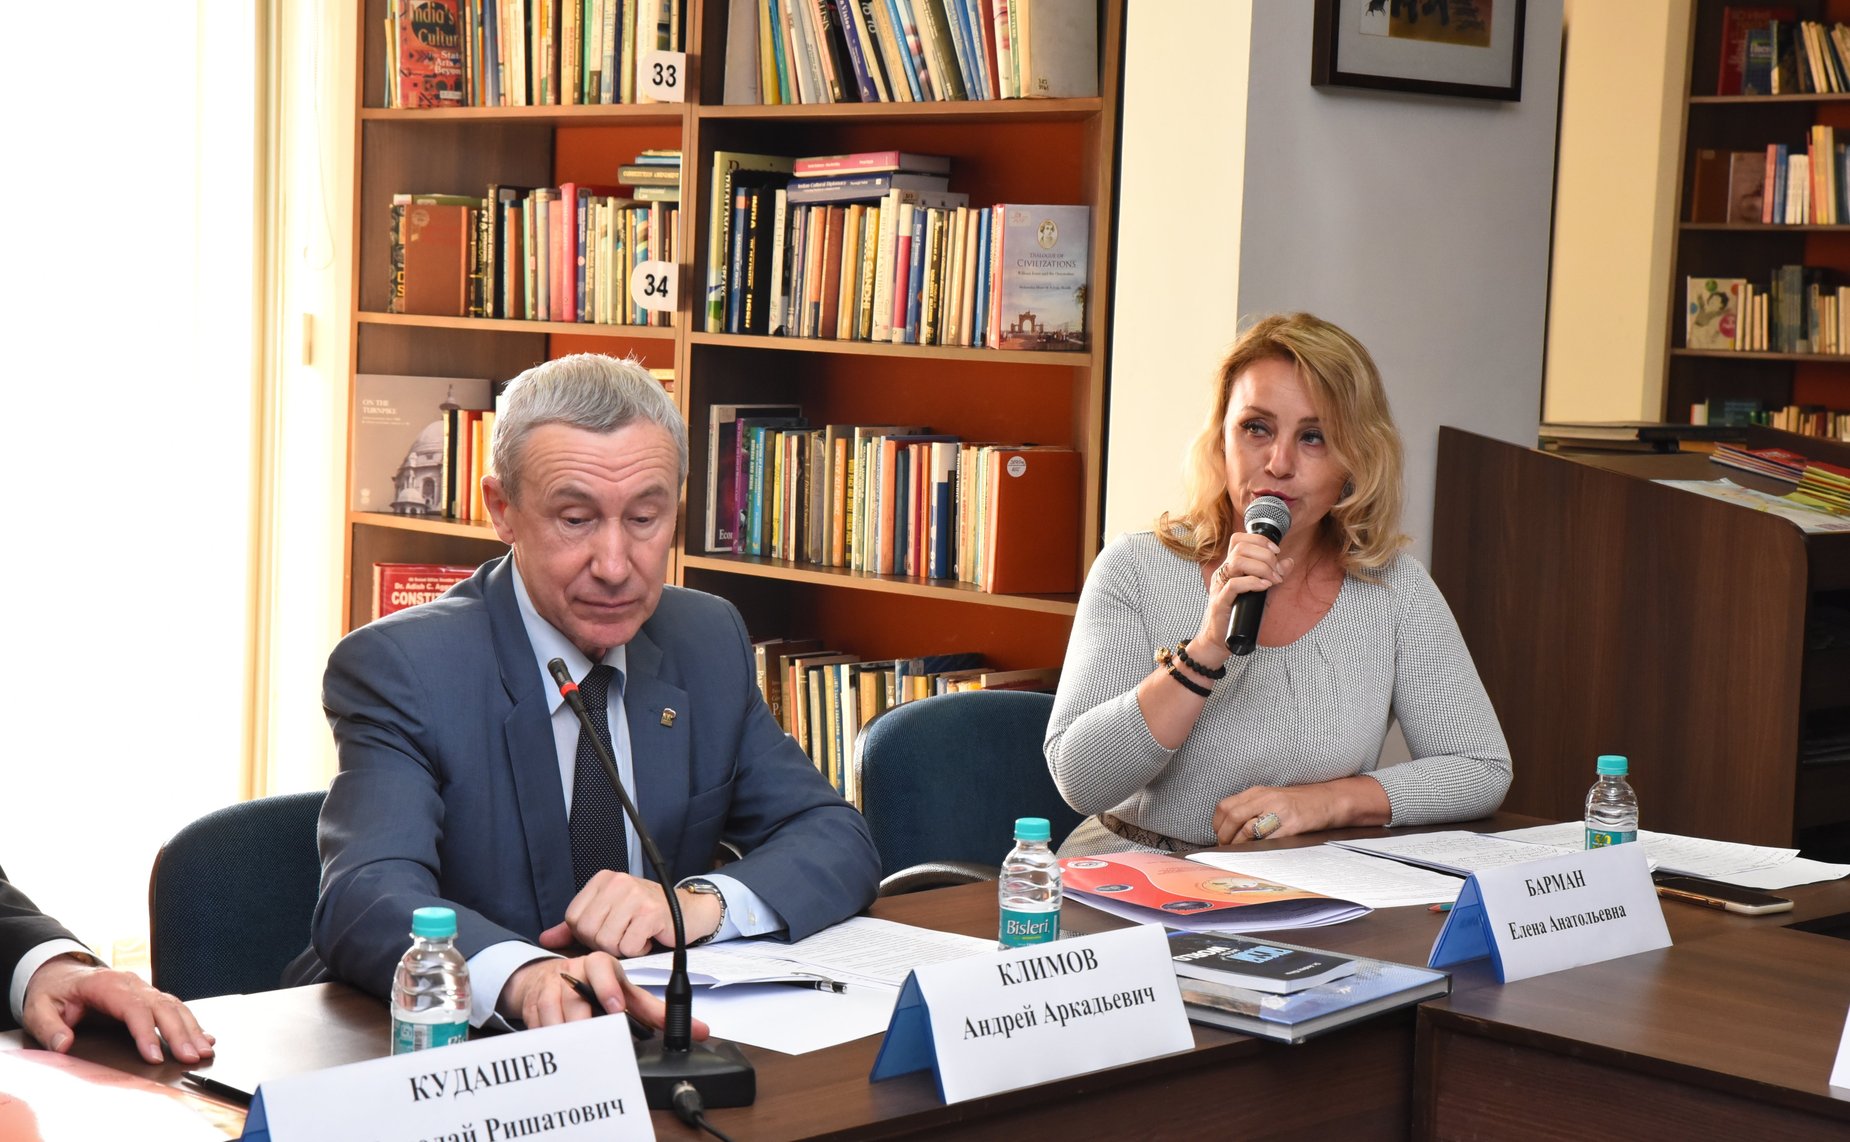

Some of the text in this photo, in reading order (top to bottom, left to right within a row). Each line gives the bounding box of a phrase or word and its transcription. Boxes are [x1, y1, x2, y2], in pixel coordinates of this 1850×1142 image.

[418, 27, 460, 47] Cultur
[652, 63, 677, 87] 33
[1016, 259, 1077, 268] CIVILIZATIONS
[644, 274, 669, 297] 34
[863, 260, 874, 309] GANDHI
[1525, 869, 1586, 897] БАРМАН
[1007, 919, 1049, 935] Bisleri
[1508, 904, 1627, 941] Елена Анатольевна
[997, 948, 1099, 987] КЛИМОВ
[963, 987, 1156, 1041] Андрей Аркадьевич
[410, 1051, 558, 1102] КУДАШЕВ
[484, 1098, 626, 1142] Ришатович
